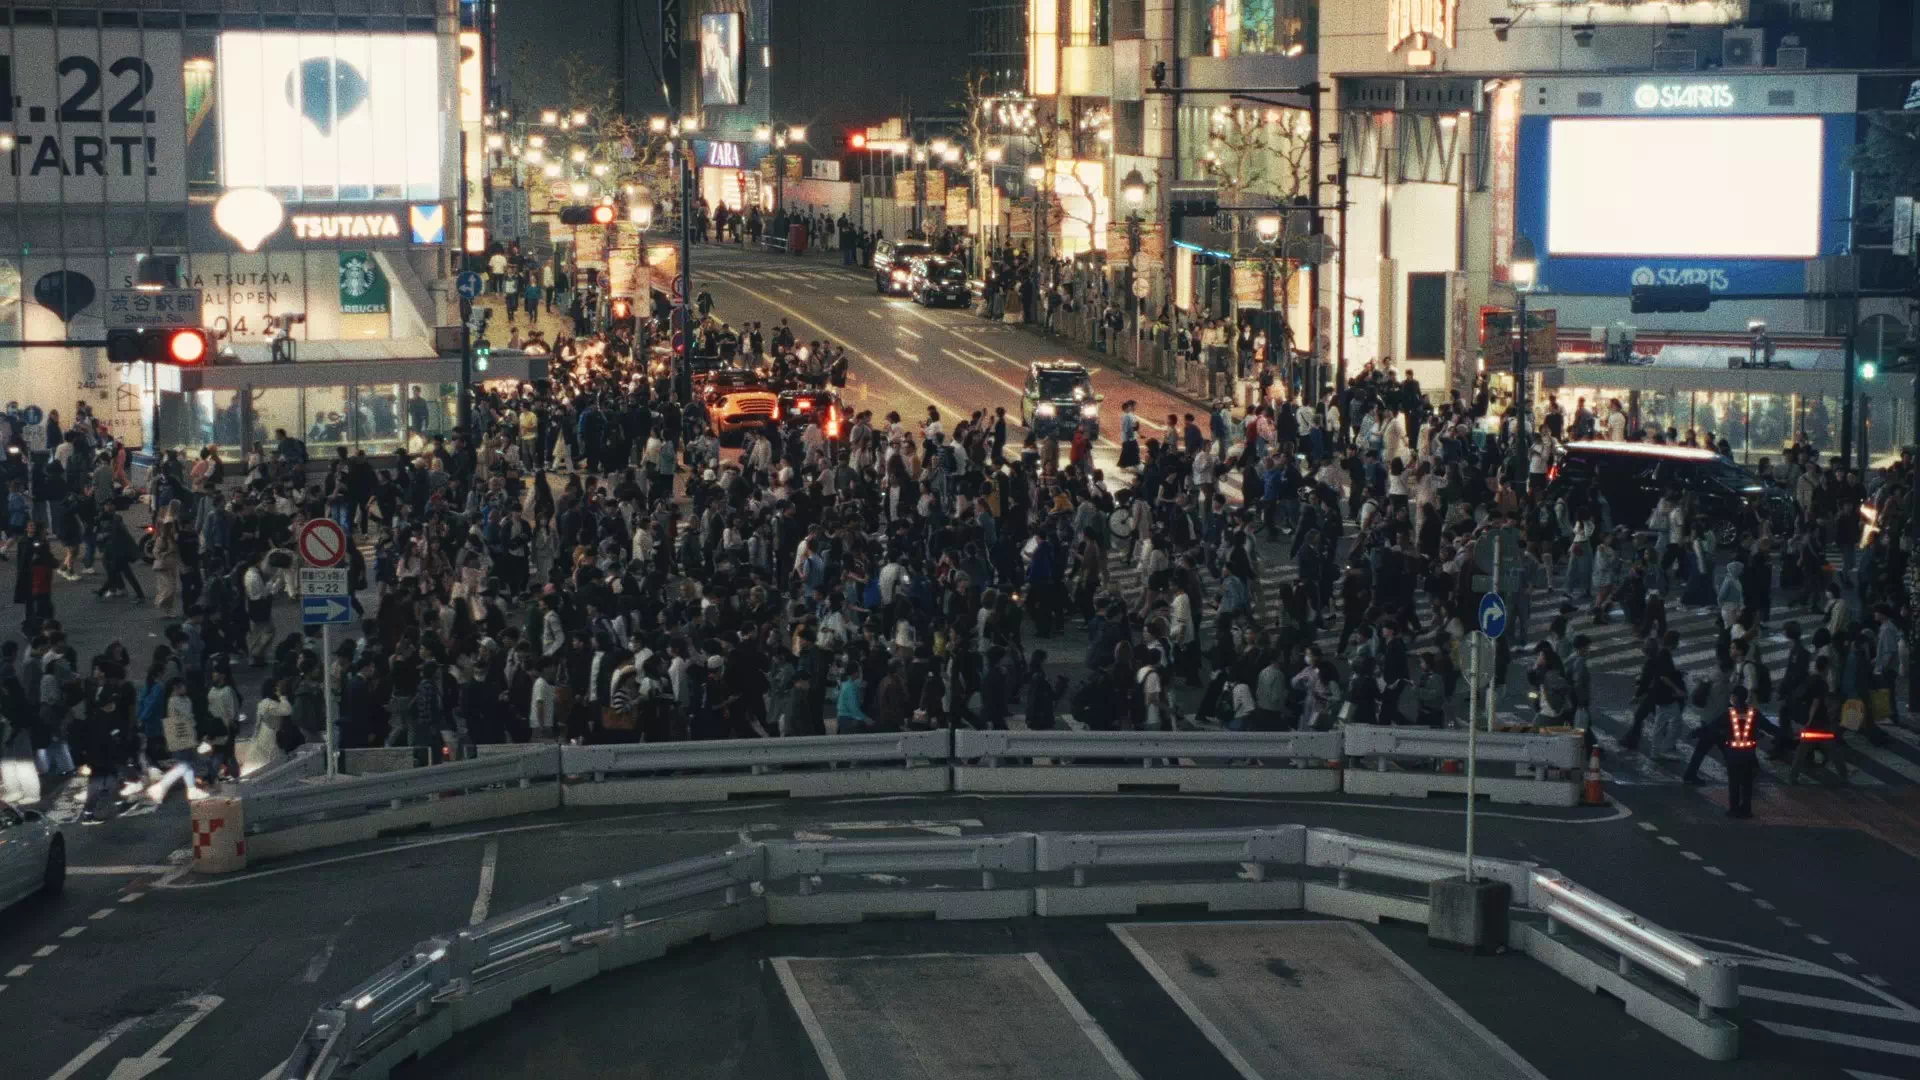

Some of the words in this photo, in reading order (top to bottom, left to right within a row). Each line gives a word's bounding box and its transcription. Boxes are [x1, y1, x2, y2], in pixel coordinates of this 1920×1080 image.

[0, 55, 156, 123] .22
[1660, 84, 1734, 107] STARTS
[710, 142, 740, 166] ZARA
[292, 214, 400, 238] TSUTAYA
[213, 272, 292, 287] TSUTAYA
[111, 294, 195, 313] 渋谷駅前
[233, 292, 278, 304] OPEN
